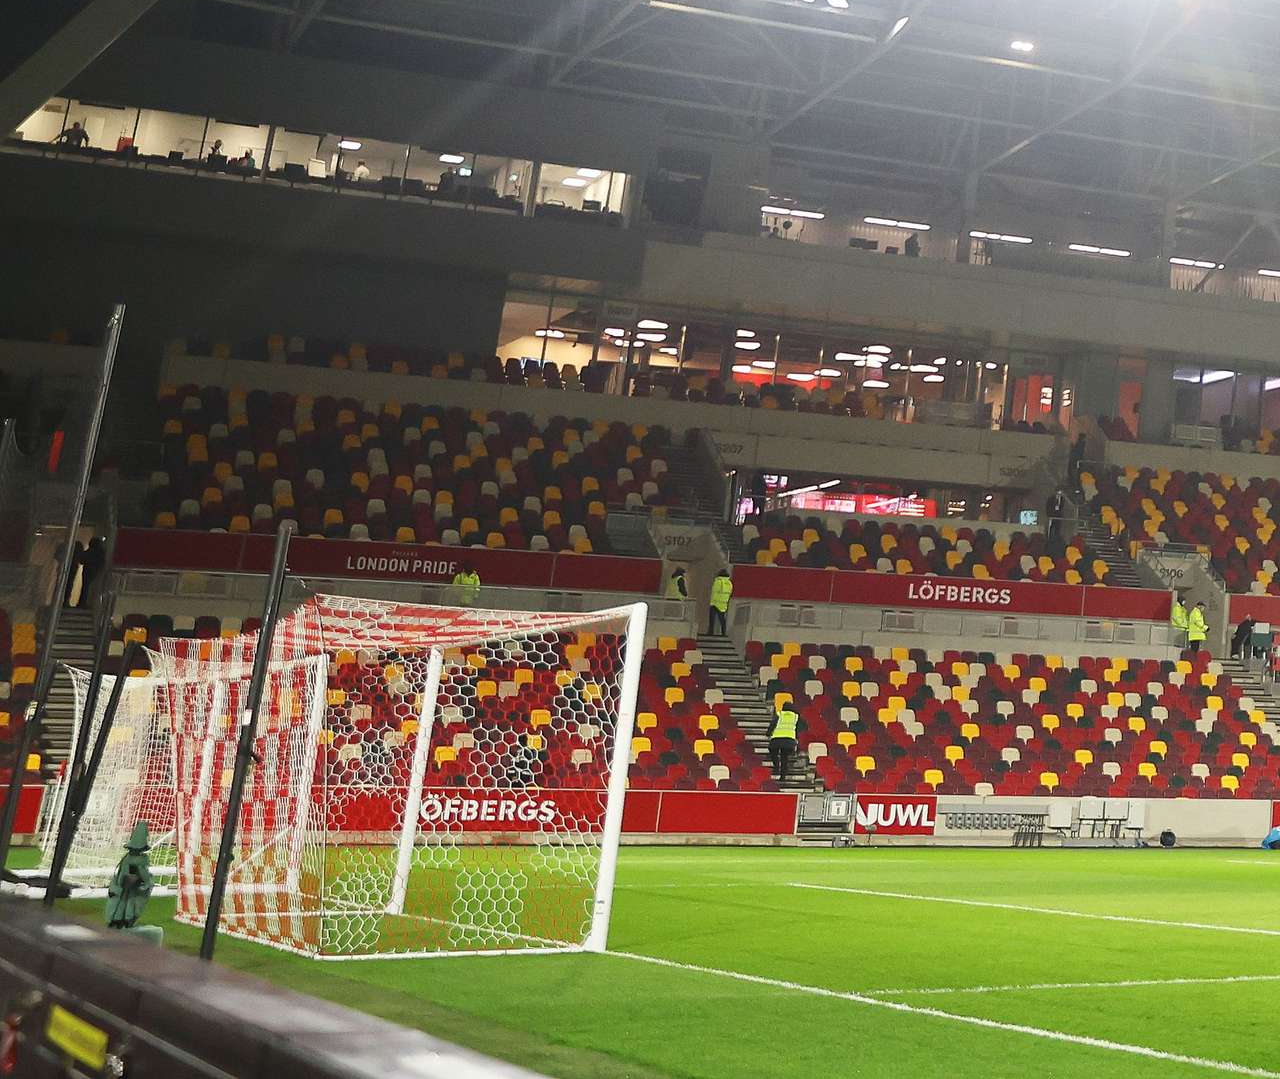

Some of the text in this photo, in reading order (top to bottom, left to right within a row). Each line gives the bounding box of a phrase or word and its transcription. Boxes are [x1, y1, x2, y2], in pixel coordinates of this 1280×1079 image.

[346, 555, 457, 575] LONDON PRIDE
[908, 580, 1011, 605] LÖFBERGS
[420, 793, 557, 822] ÖFBERGS
